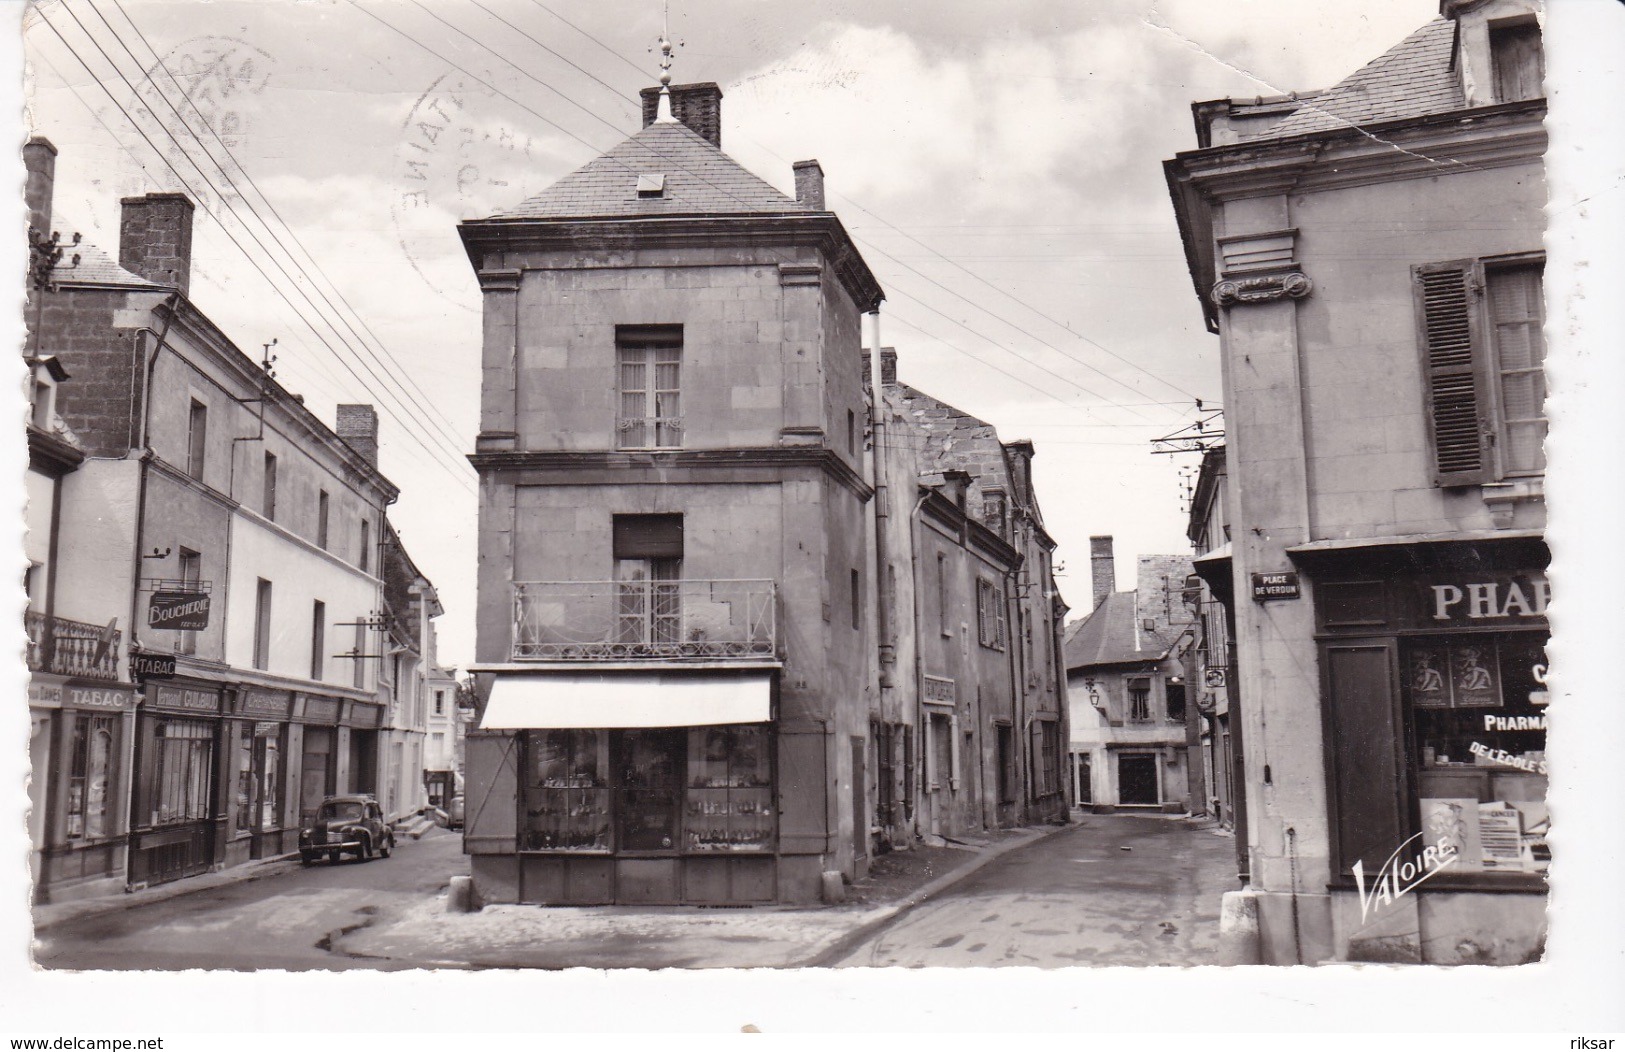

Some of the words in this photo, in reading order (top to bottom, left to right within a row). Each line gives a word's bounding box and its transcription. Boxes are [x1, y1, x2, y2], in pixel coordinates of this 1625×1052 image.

[1262, 576, 1288, 584] PLACE
[1255, 587, 1265, 595] DE
[1266, 585, 1297, 594] VERDUN
[148, 598, 209, 625] BOUCHERIE
[138, 658, 176, 675] TABAC
[71, 689, 123, 707] TABAC
[1469, 741, 1489, 757] DE
